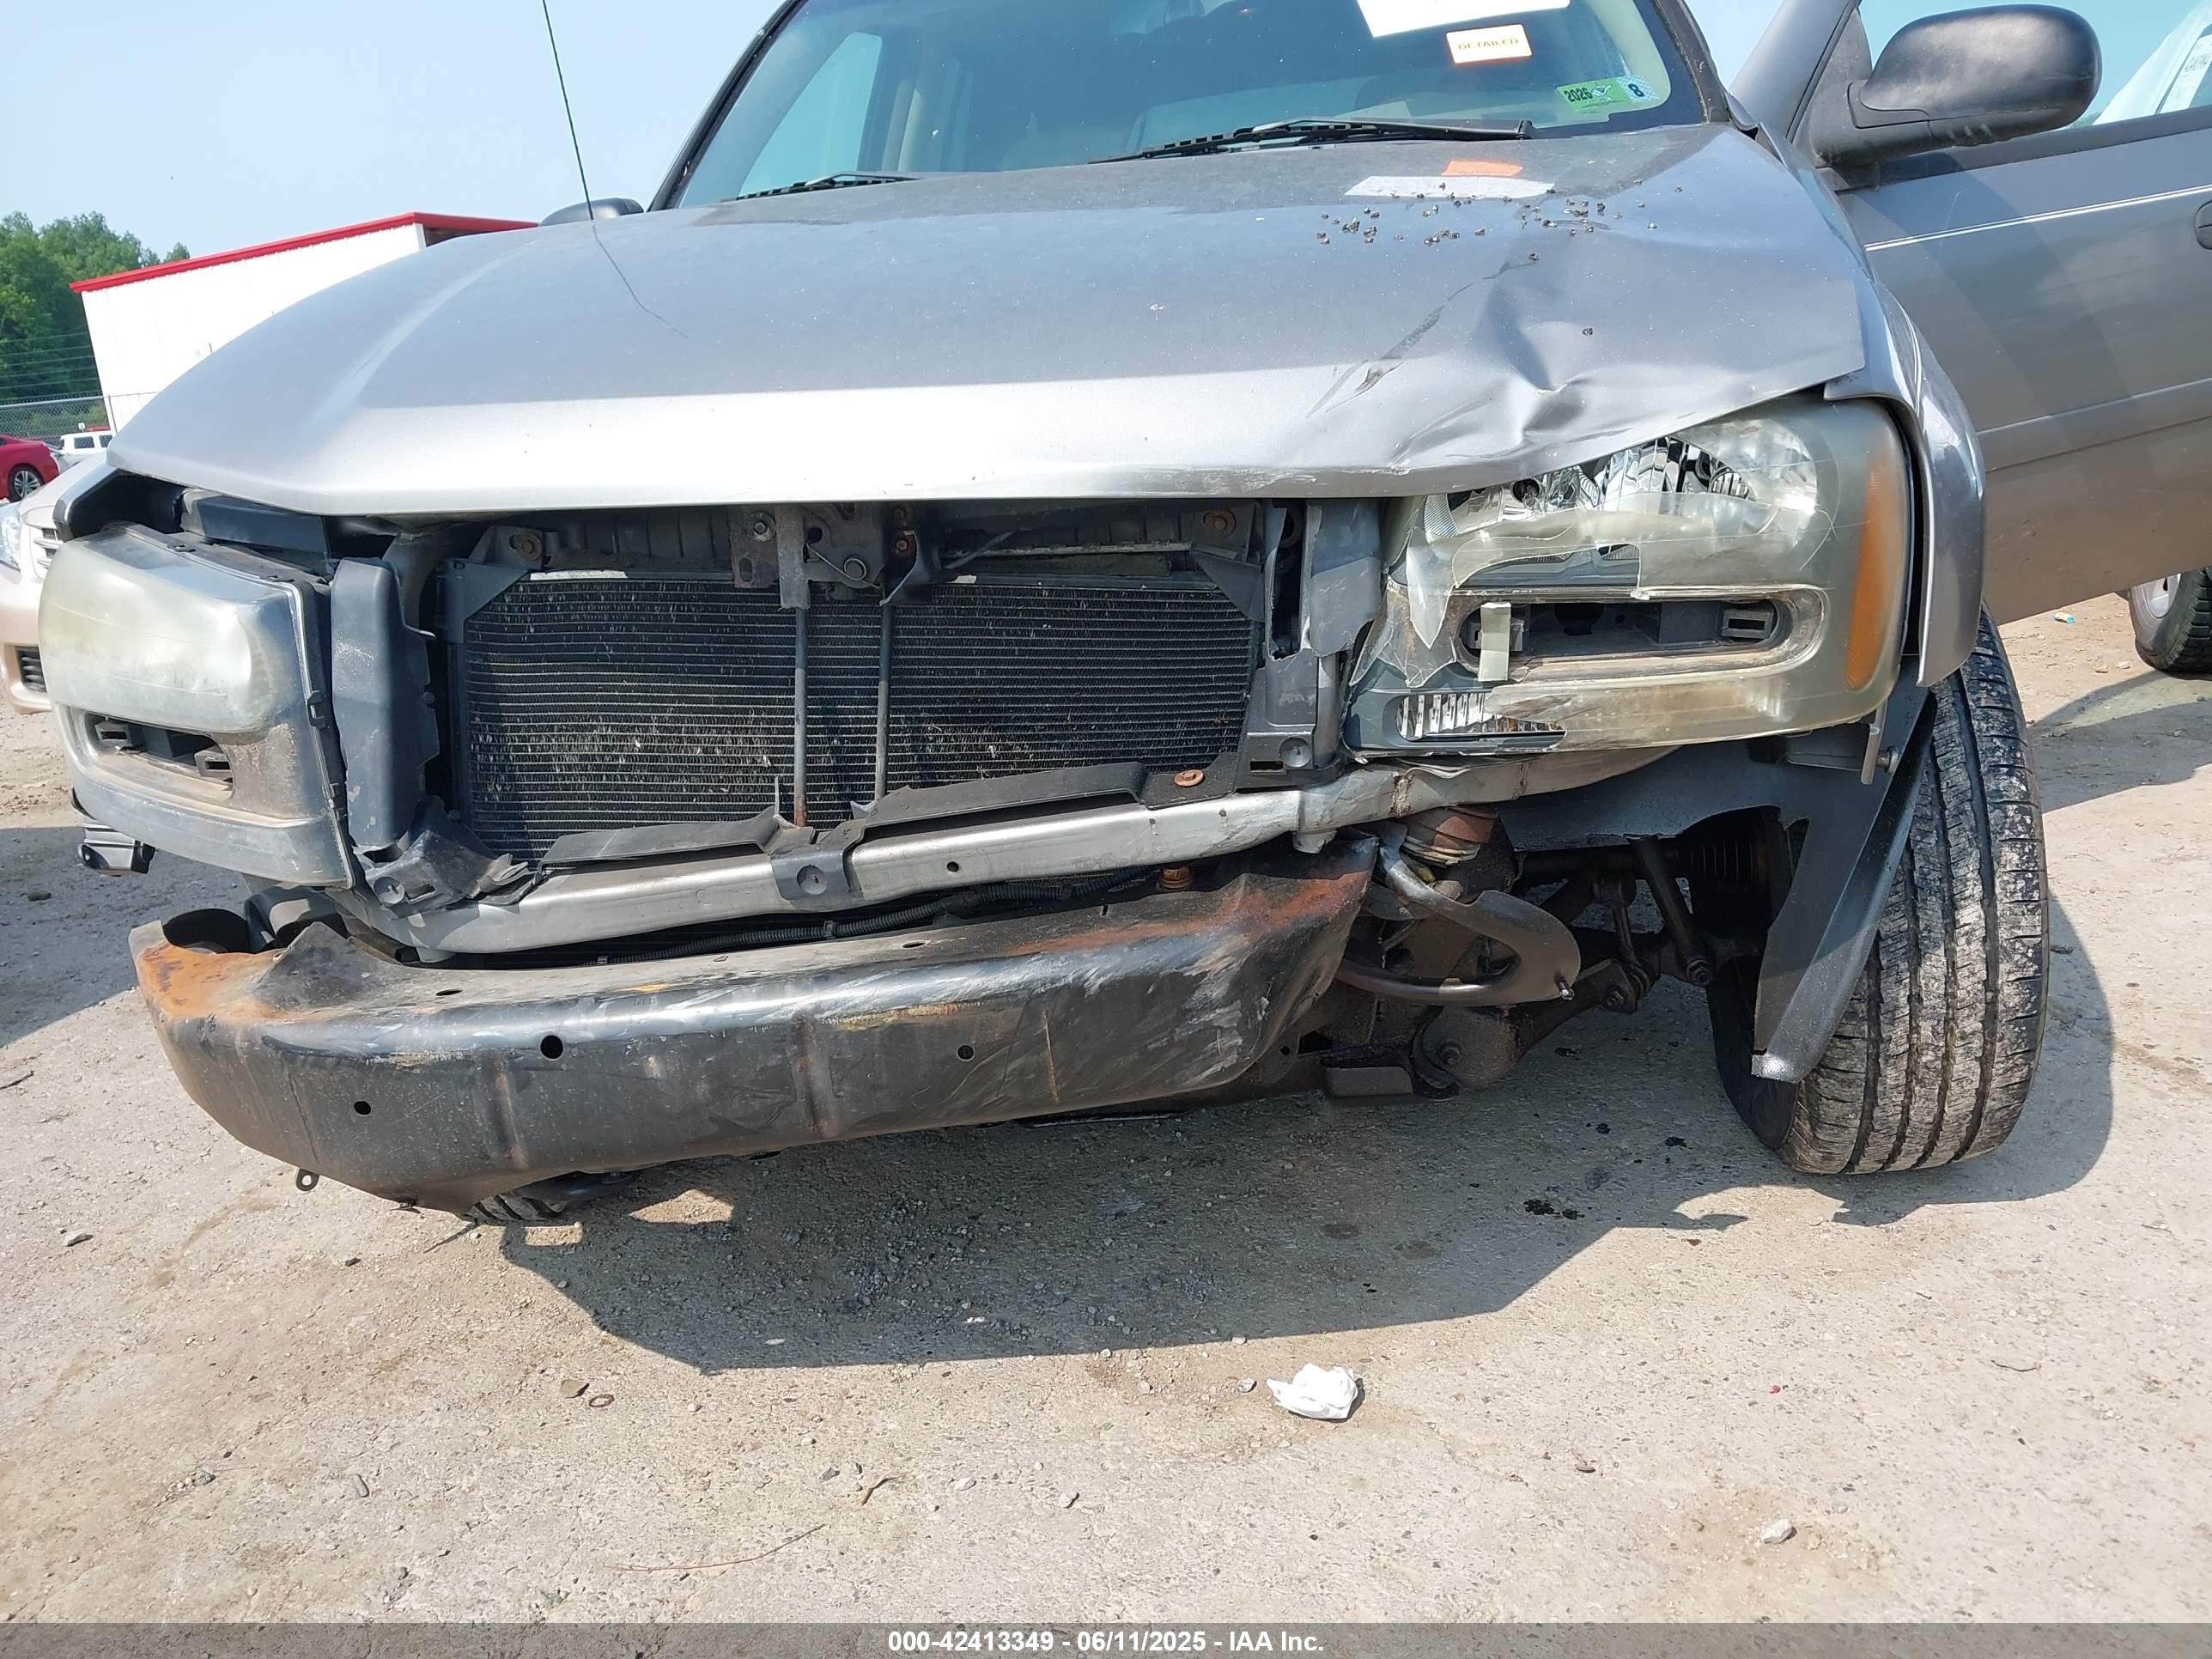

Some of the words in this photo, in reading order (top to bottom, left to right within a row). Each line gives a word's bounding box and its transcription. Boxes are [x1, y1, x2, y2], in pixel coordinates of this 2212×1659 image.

[1457, 38, 1519, 50] DETAILED
[1563, 87, 1594, 102] 2026
[1627, 83, 1645, 97] 8
